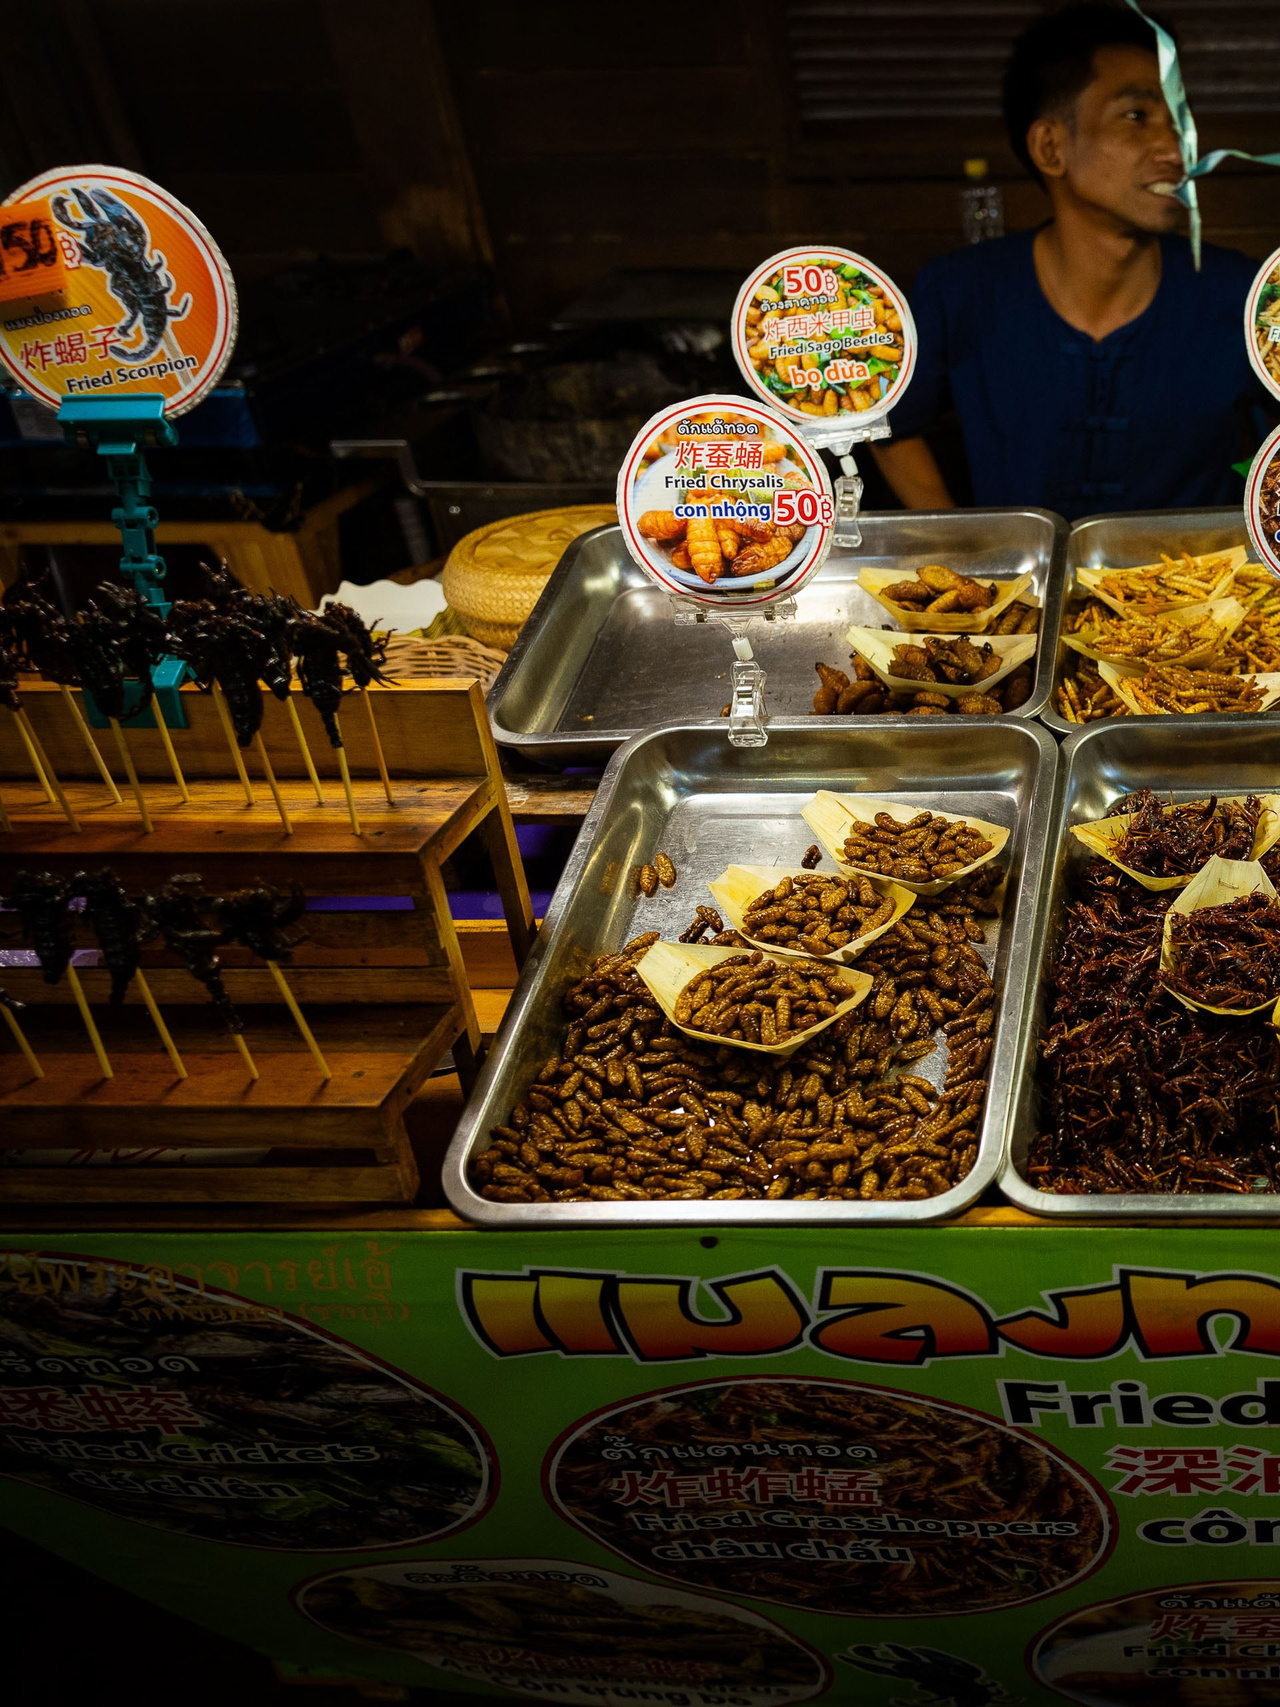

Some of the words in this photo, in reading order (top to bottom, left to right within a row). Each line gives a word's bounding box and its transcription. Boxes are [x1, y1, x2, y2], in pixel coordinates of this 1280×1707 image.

[4, 304, 92, 331] แมงป่องทอด
[764, 308, 875, 341] 炸西米甲虫
[20, 326, 121, 371] 炸蝎子
[769, 342, 803, 358] Fried
[807, 340, 842, 354] Sago
[843, 332, 893, 347] Beetles
[66, 372, 114, 393] Fried
[117, 355, 197, 387] Scorpion
[791, 367, 820, 390] bọ
[826, 360, 868, 380] dừa
[674, 443, 763, 470] 炸蚕蛹
[665, 475, 706, 489] Fried
[710, 475, 784, 491] Chrysalis
[675, 504, 707, 518] con
[712, 501, 771, 521] nhộng
[8, 1434, 155, 1462] Fried
[159, 1442, 381, 1464] Crickets
[600, 1433, 880, 1462] ตั๊กแตนทอด
[147, 1475, 303, 1499] chiên
[612, 1467, 882, 1508] 炸蚱蜢
[634, 1512, 760, 1532] Fried
[762, 1511, 1080, 1540] Grasshoppers
[652, 1538, 783, 1563] châu
[788, 1538, 915, 1564] chấu
[1124, 1644, 1227, 1658] Fried
[1149, 1667, 1231, 1679] con
